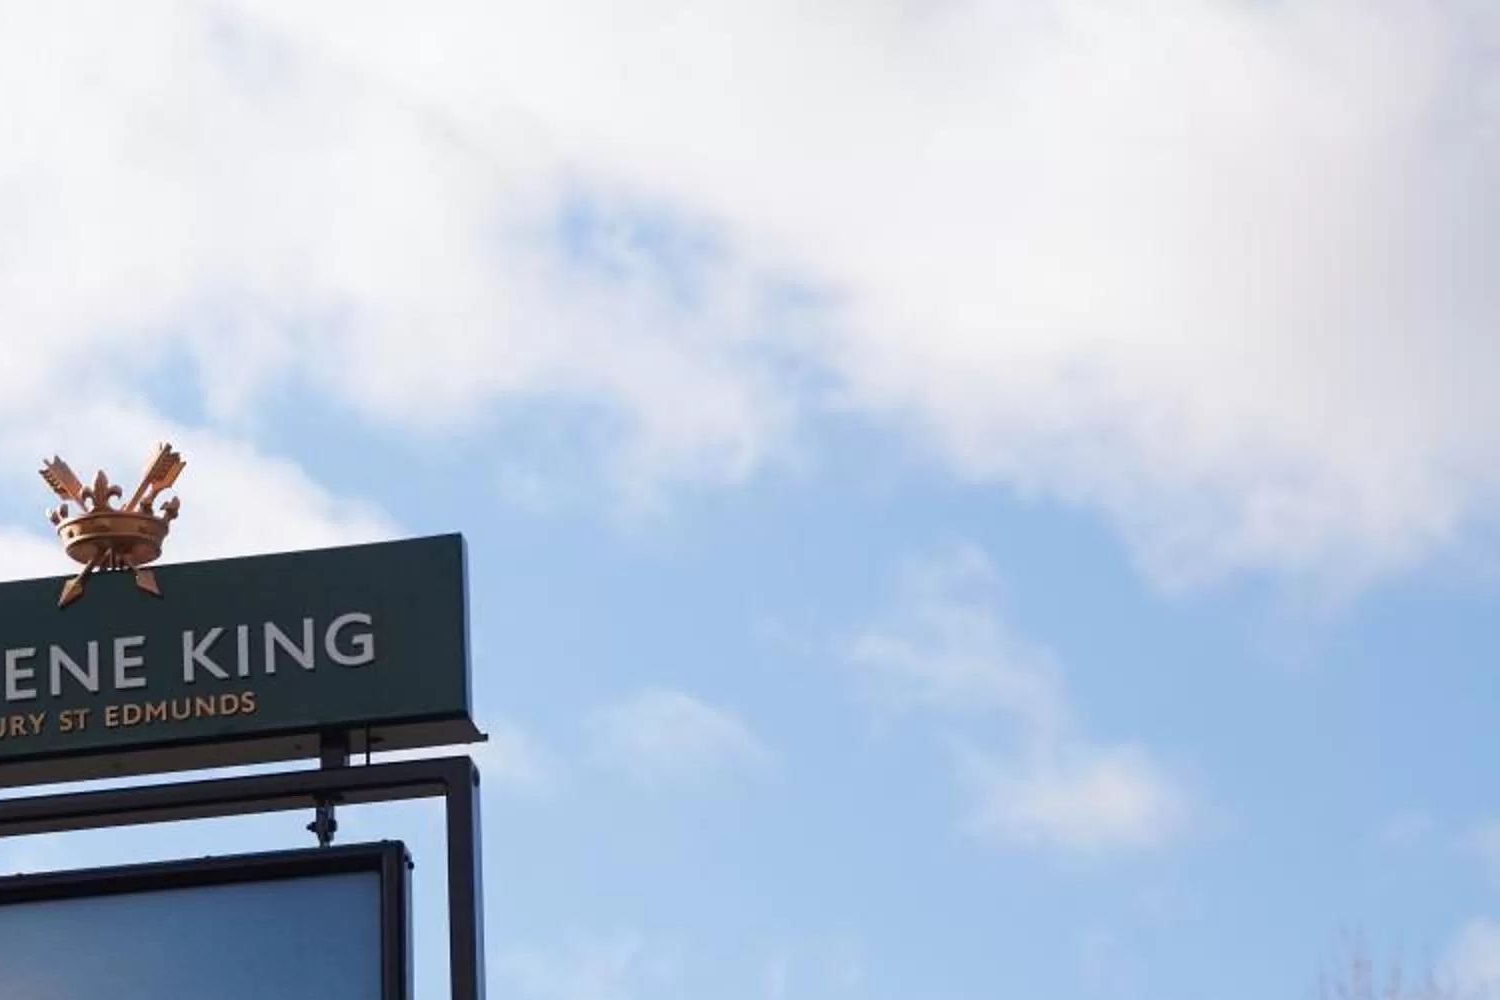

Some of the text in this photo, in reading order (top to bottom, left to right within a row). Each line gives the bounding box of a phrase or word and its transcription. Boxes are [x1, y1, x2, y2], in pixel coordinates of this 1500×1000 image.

[181, 612, 376, 683] KING
[60, 708, 91, 733] ST
[104, 691, 257, 728] EDMUNDS
